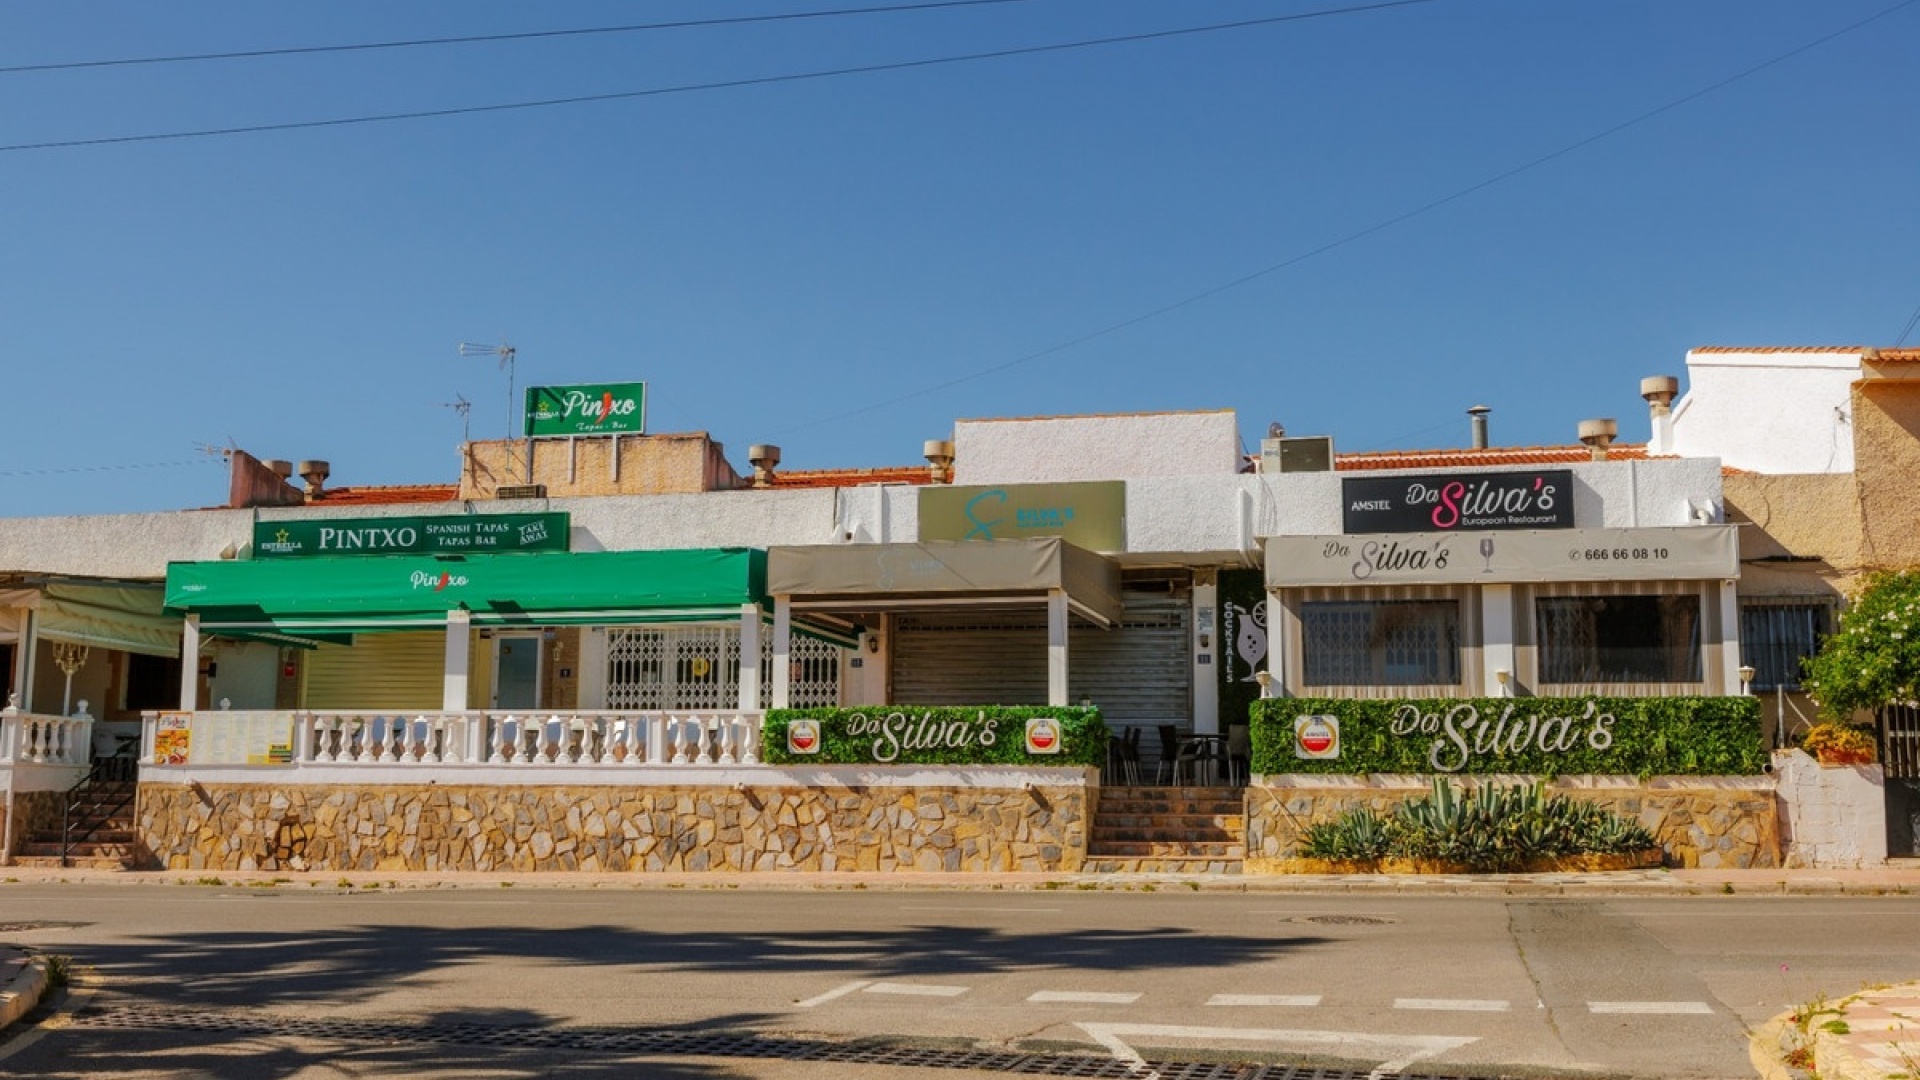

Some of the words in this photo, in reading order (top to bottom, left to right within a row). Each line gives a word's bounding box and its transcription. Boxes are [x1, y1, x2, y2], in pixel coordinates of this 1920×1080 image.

[1351, 500, 1391, 512] AMSTEL
[1405, 483, 1440, 505] Da
[1431, 478, 1556, 528] Silva's
[426, 524, 470, 534] SPANISH
[475, 522, 510, 533] TAPAS
[1462, 516, 1506, 527] European
[1508, 514, 1557, 524] Restaurant
[319, 527, 417, 549] PINTXO
[438, 536, 471, 546] TAPAS
[475, 535, 497, 545] BAR
[1323, 540, 1349, 558] Da
[1352, 541, 1449, 580] Silva's
[1585, 549, 1608, 560] 666
[1612, 549, 1628, 559] 66
[1632, 548, 1648, 559] 08
[1653, 548, 1668, 559] 10
[1223, 601, 1234, 683] COCKTAILS
[846, 712, 881, 735] Da
[872, 711, 998, 762] Silva's
[1391, 705, 1440, 735] Da
[1431, 700, 1616, 772] Silva's
